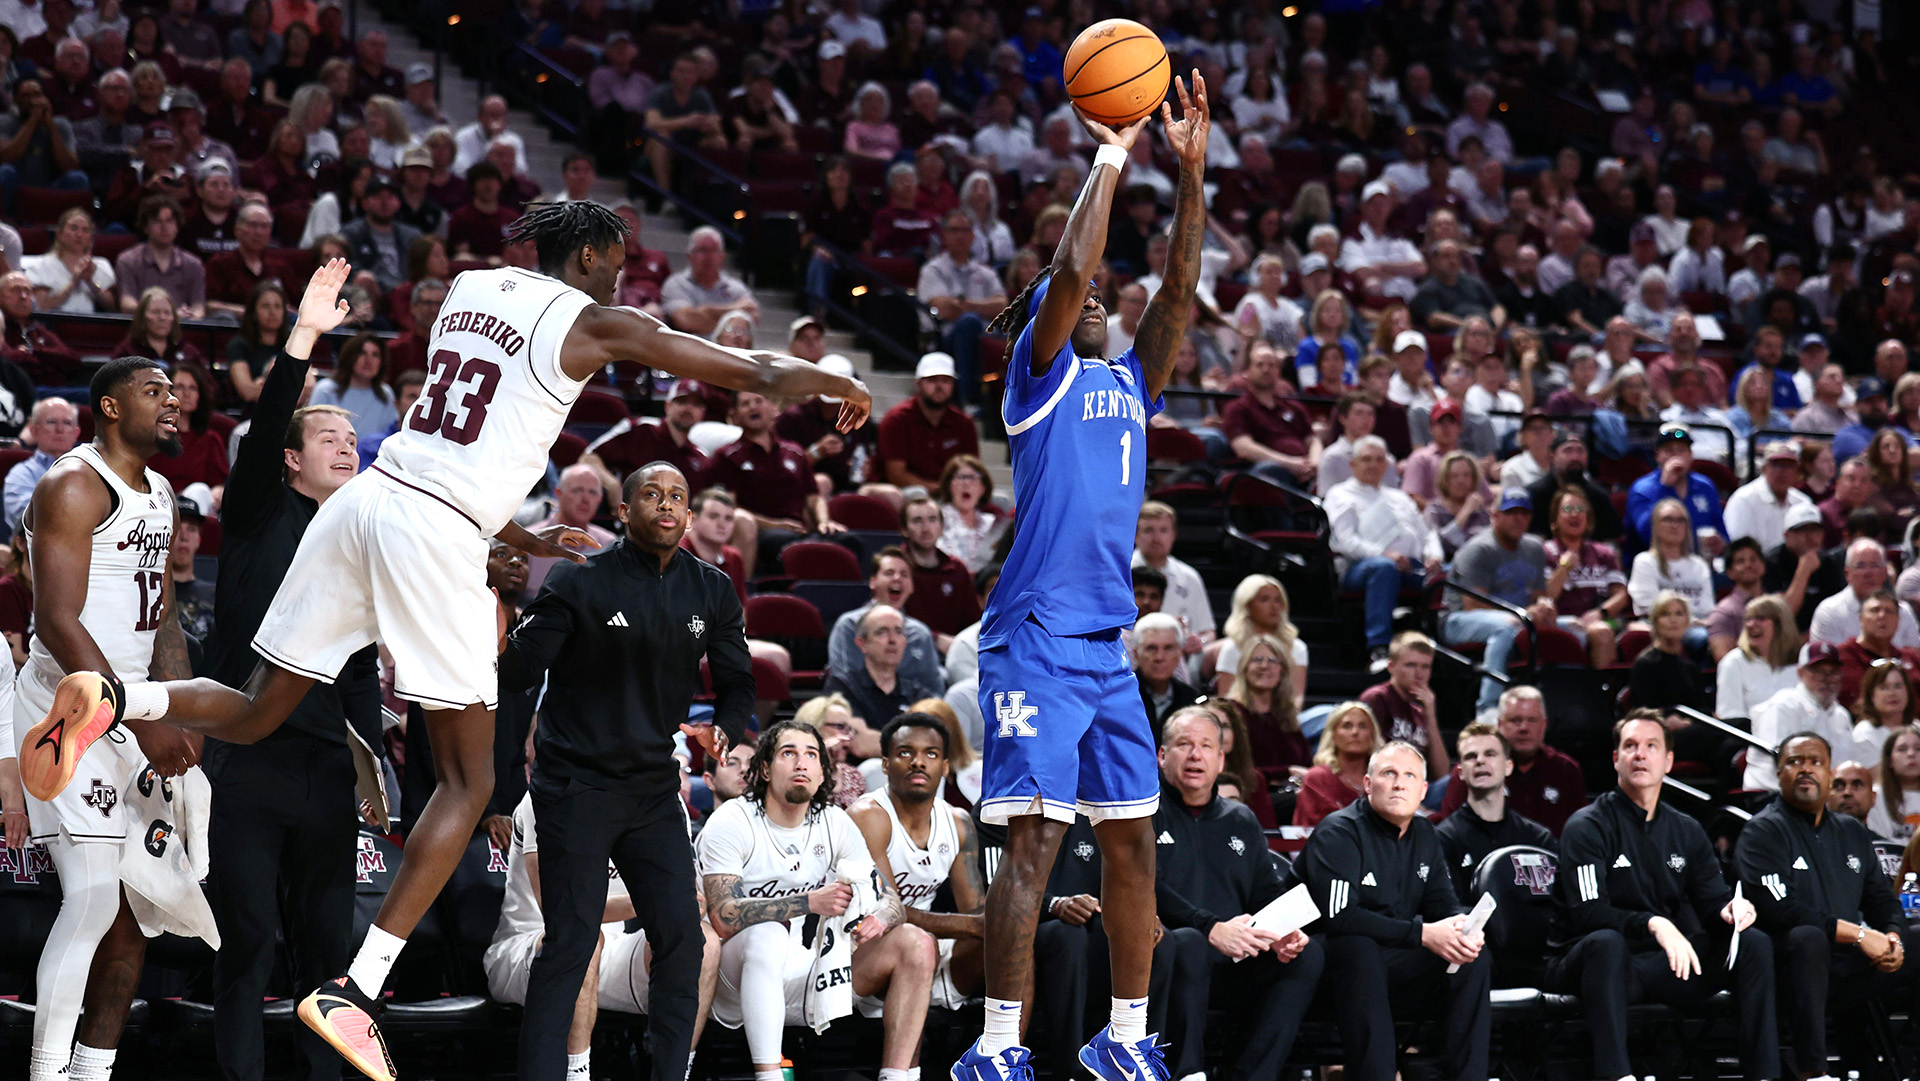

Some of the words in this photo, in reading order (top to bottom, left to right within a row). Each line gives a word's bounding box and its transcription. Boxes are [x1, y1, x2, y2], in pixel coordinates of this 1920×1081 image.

[439, 311, 525, 357] FEDERIKO
[409, 349, 502, 446] 33
[1120, 430, 1131, 486] 1
[134, 571, 163, 632] 12
[994, 690, 1038, 738] UK
